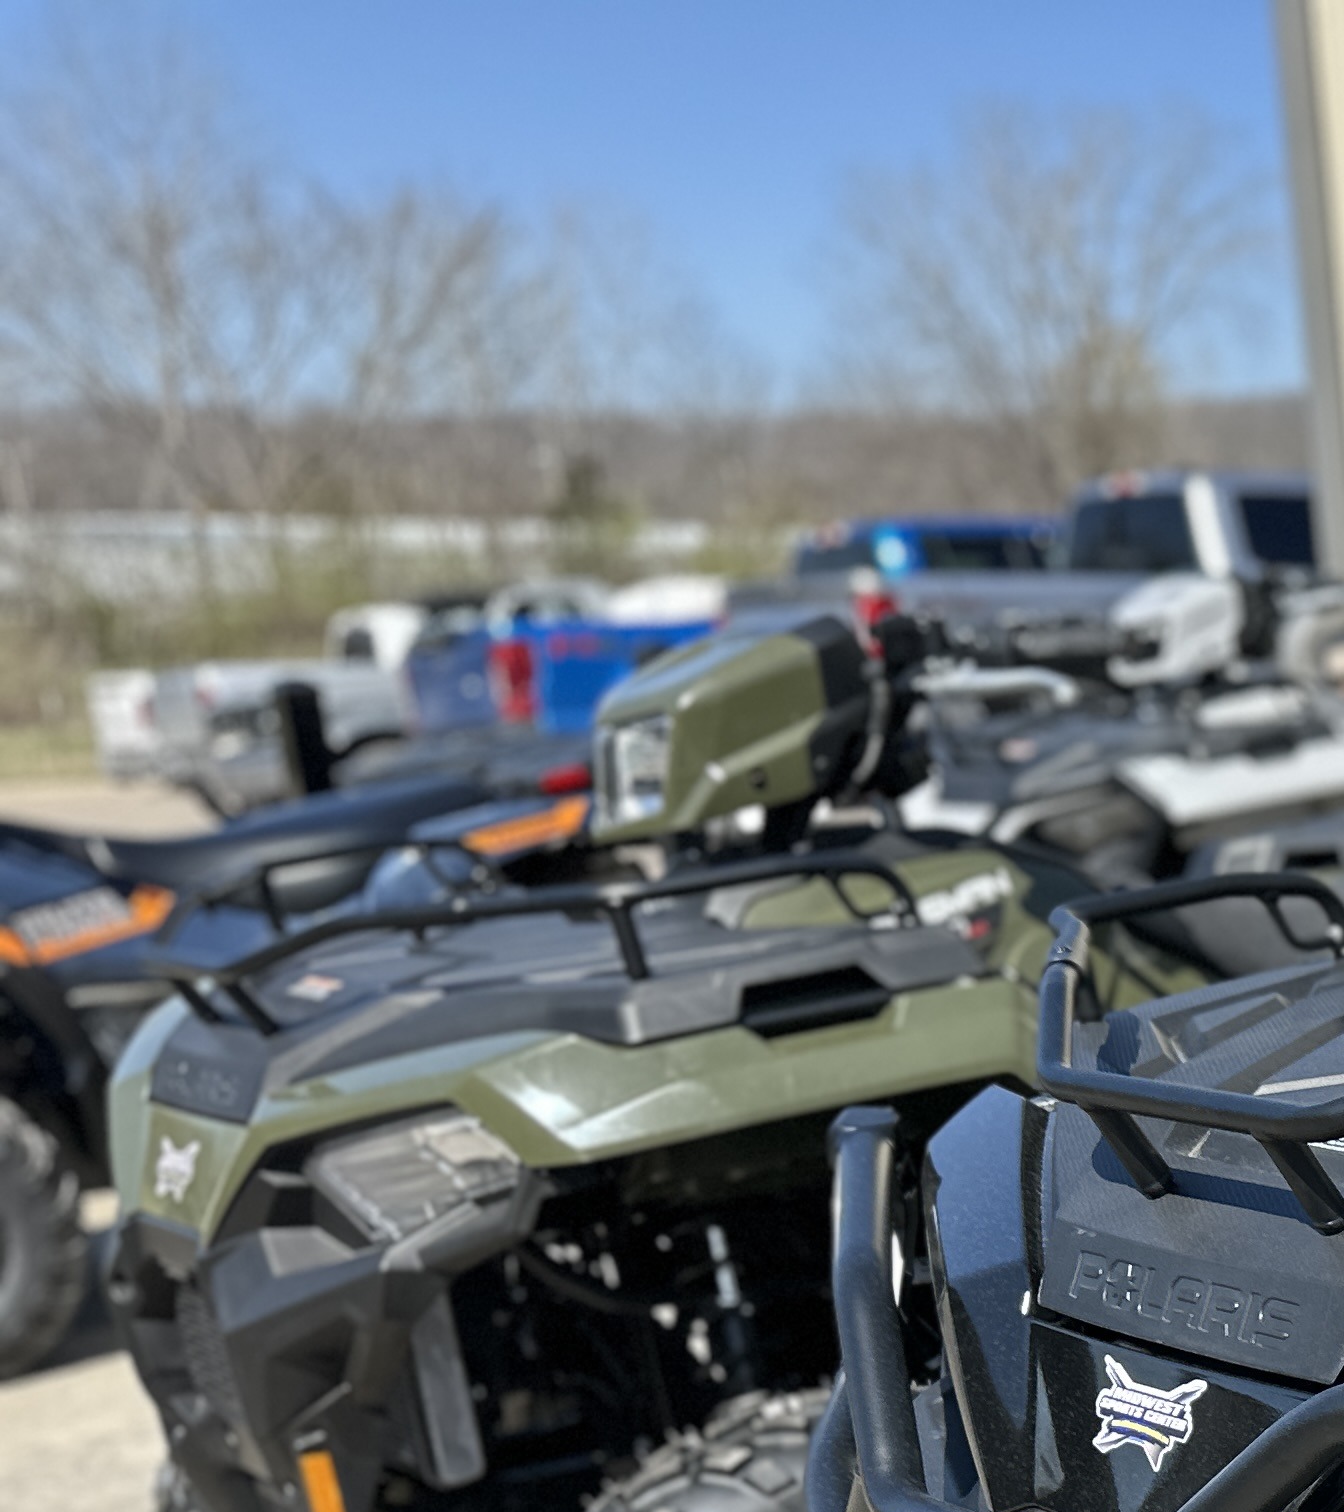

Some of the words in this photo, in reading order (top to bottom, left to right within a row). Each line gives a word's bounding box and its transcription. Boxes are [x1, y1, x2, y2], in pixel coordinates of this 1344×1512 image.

[1067, 1249, 1301, 1350] POLARIS
[1100, 1397, 1145, 1419] SPORTS
[1143, 1409, 1188, 1432] CENTER
[1112, 1387, 1185, 1418] MIDWEST
